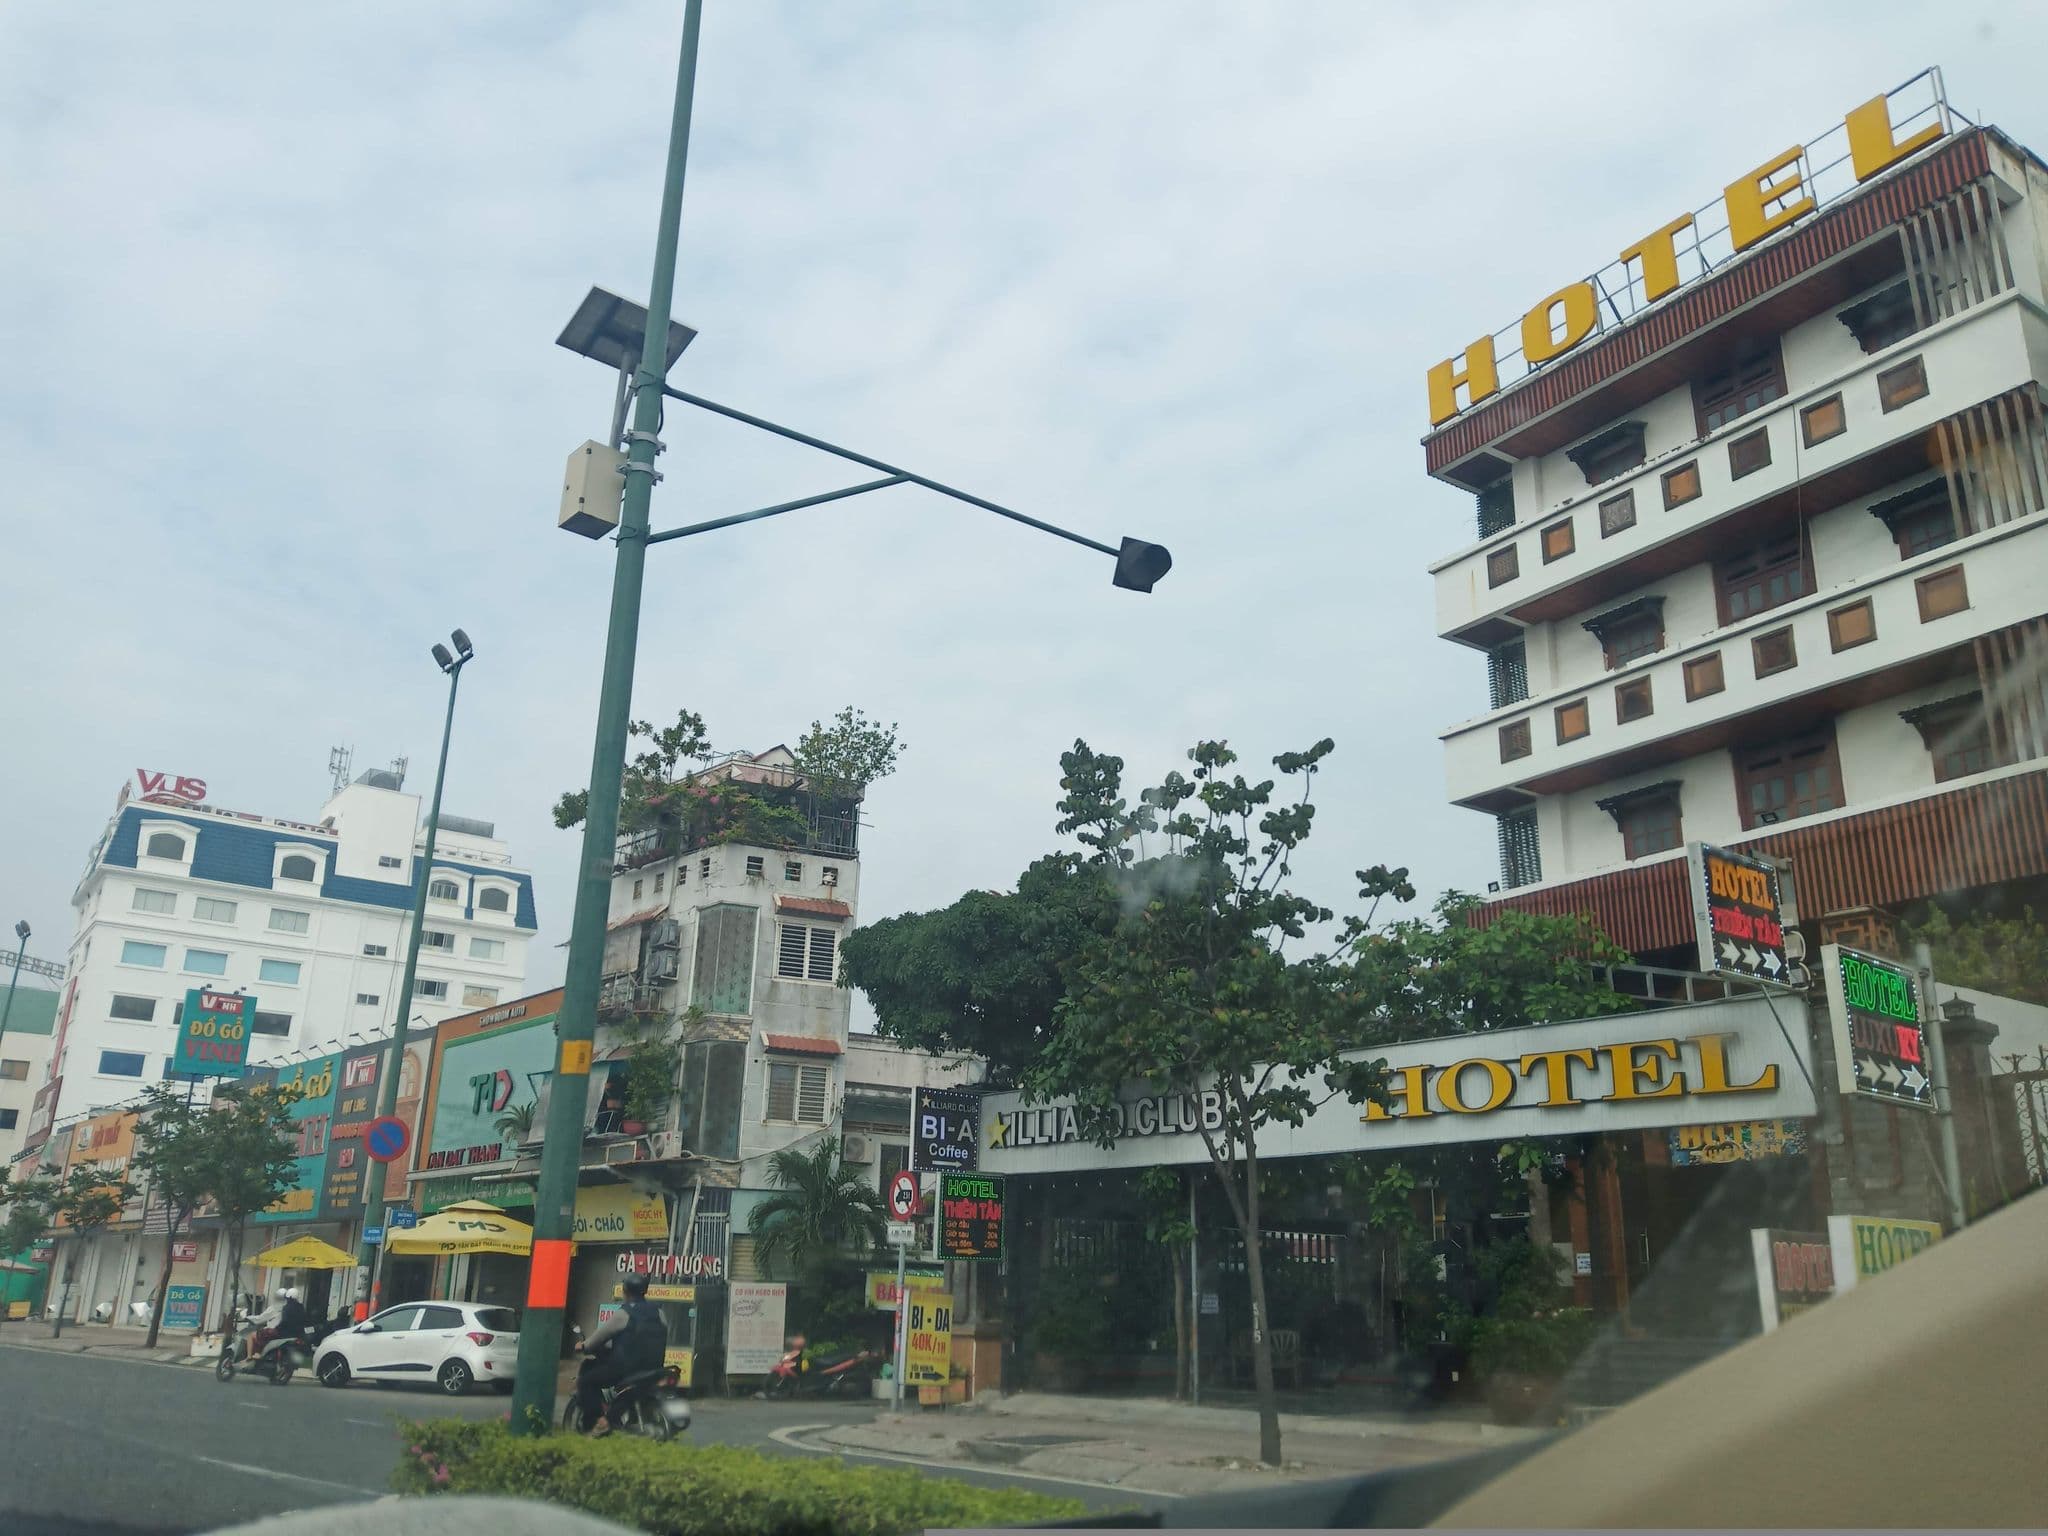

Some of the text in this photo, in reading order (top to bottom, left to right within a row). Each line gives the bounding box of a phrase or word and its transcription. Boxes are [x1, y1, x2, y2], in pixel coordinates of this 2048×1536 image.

[1427, 93, 1944, 427] HOTEL
[136, 768, 207, 800] VUS
[1708, 855, 1774, 911] HOTEL
[1842, 957, 1916, 1021] HOTEL
[185, 1039, 243, 1064] VINH
[1852, 1013, 1921, 1063] LUXURY
[1360, 1032, 1779, 1122] HOTEL
[921, 1114, 975, 1143] BI-A
[929, 1143, 969, 1159] Coffee
[947, 1179, 999, 1200] HOTEL
[594, 1213, 625, 1232] CHÁO
[616, 1250, 637, 1274] GÀ
[911, 1305, 924, 1331] BI
[934, 1307, 950, 1333] DA
